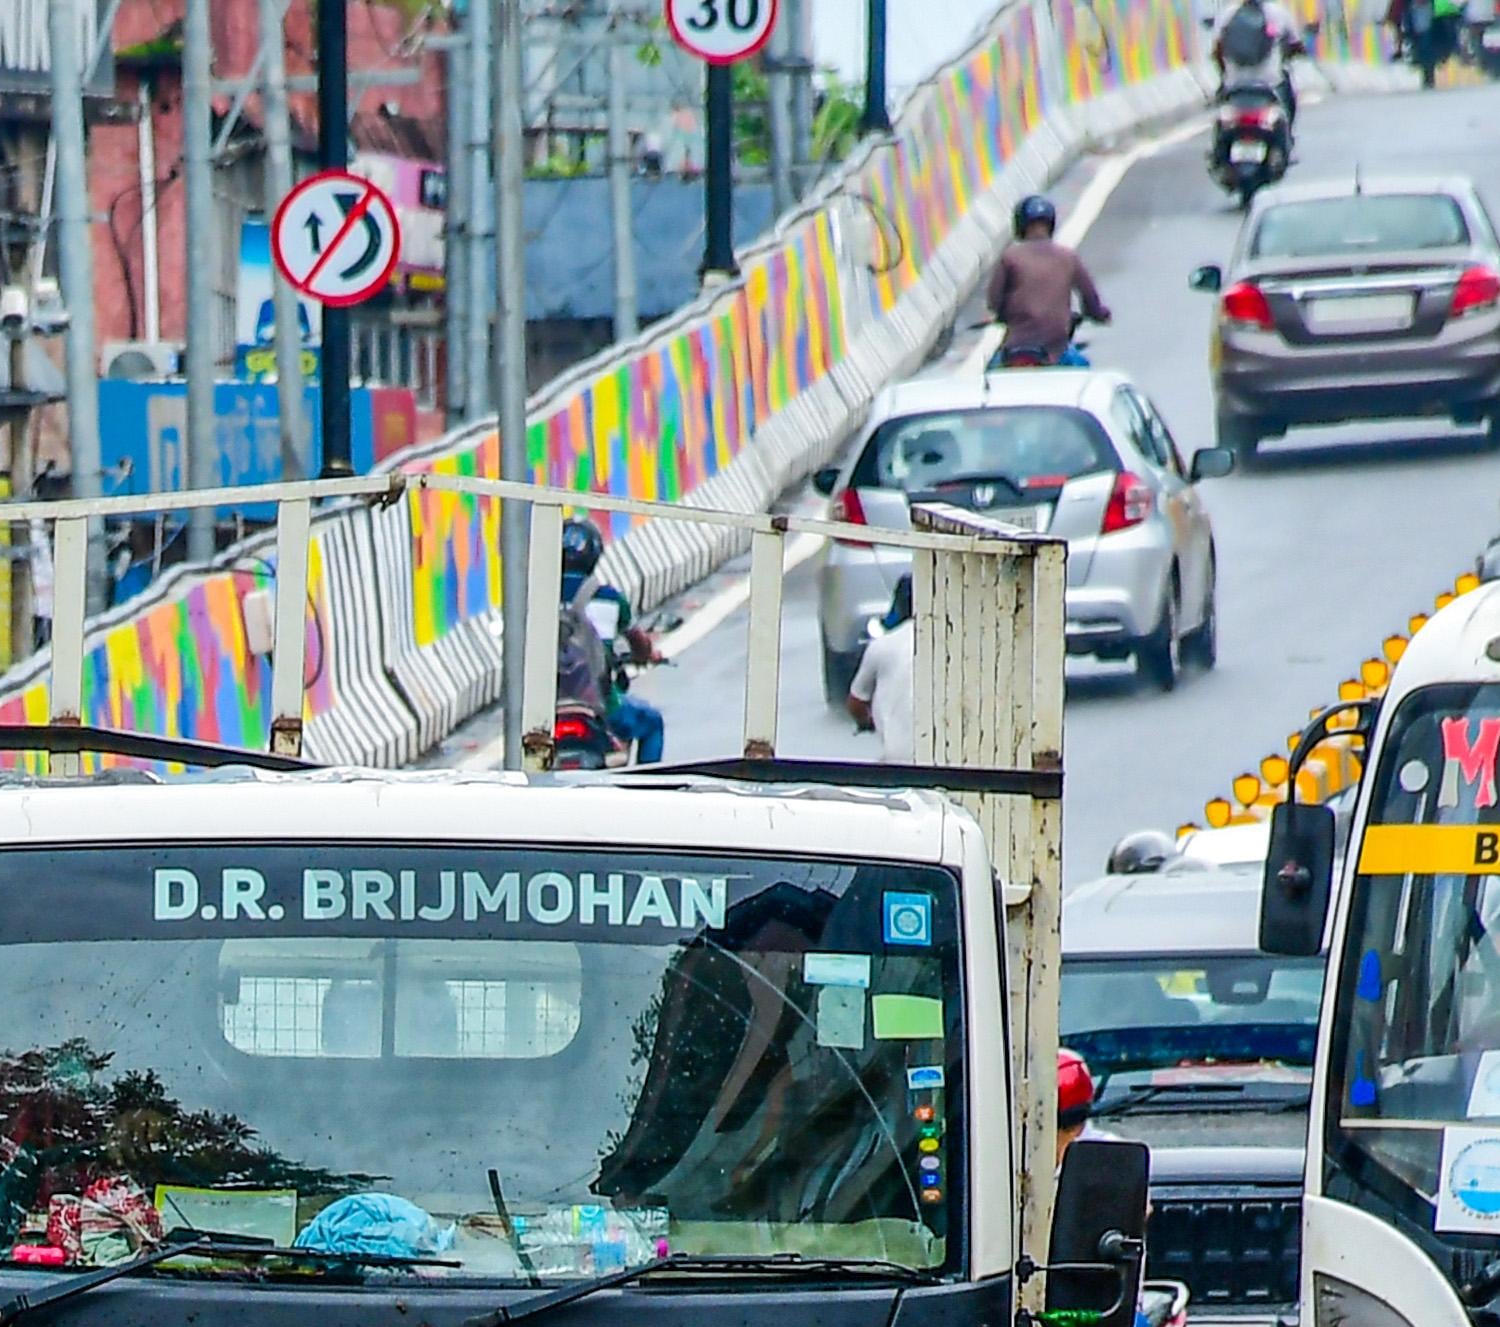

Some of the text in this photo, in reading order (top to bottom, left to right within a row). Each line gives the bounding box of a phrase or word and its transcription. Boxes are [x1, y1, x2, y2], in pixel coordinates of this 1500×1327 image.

[684, 0, 759, 33] 30
[154, 868, 727, 931] D.R. BRIJMOHAN
